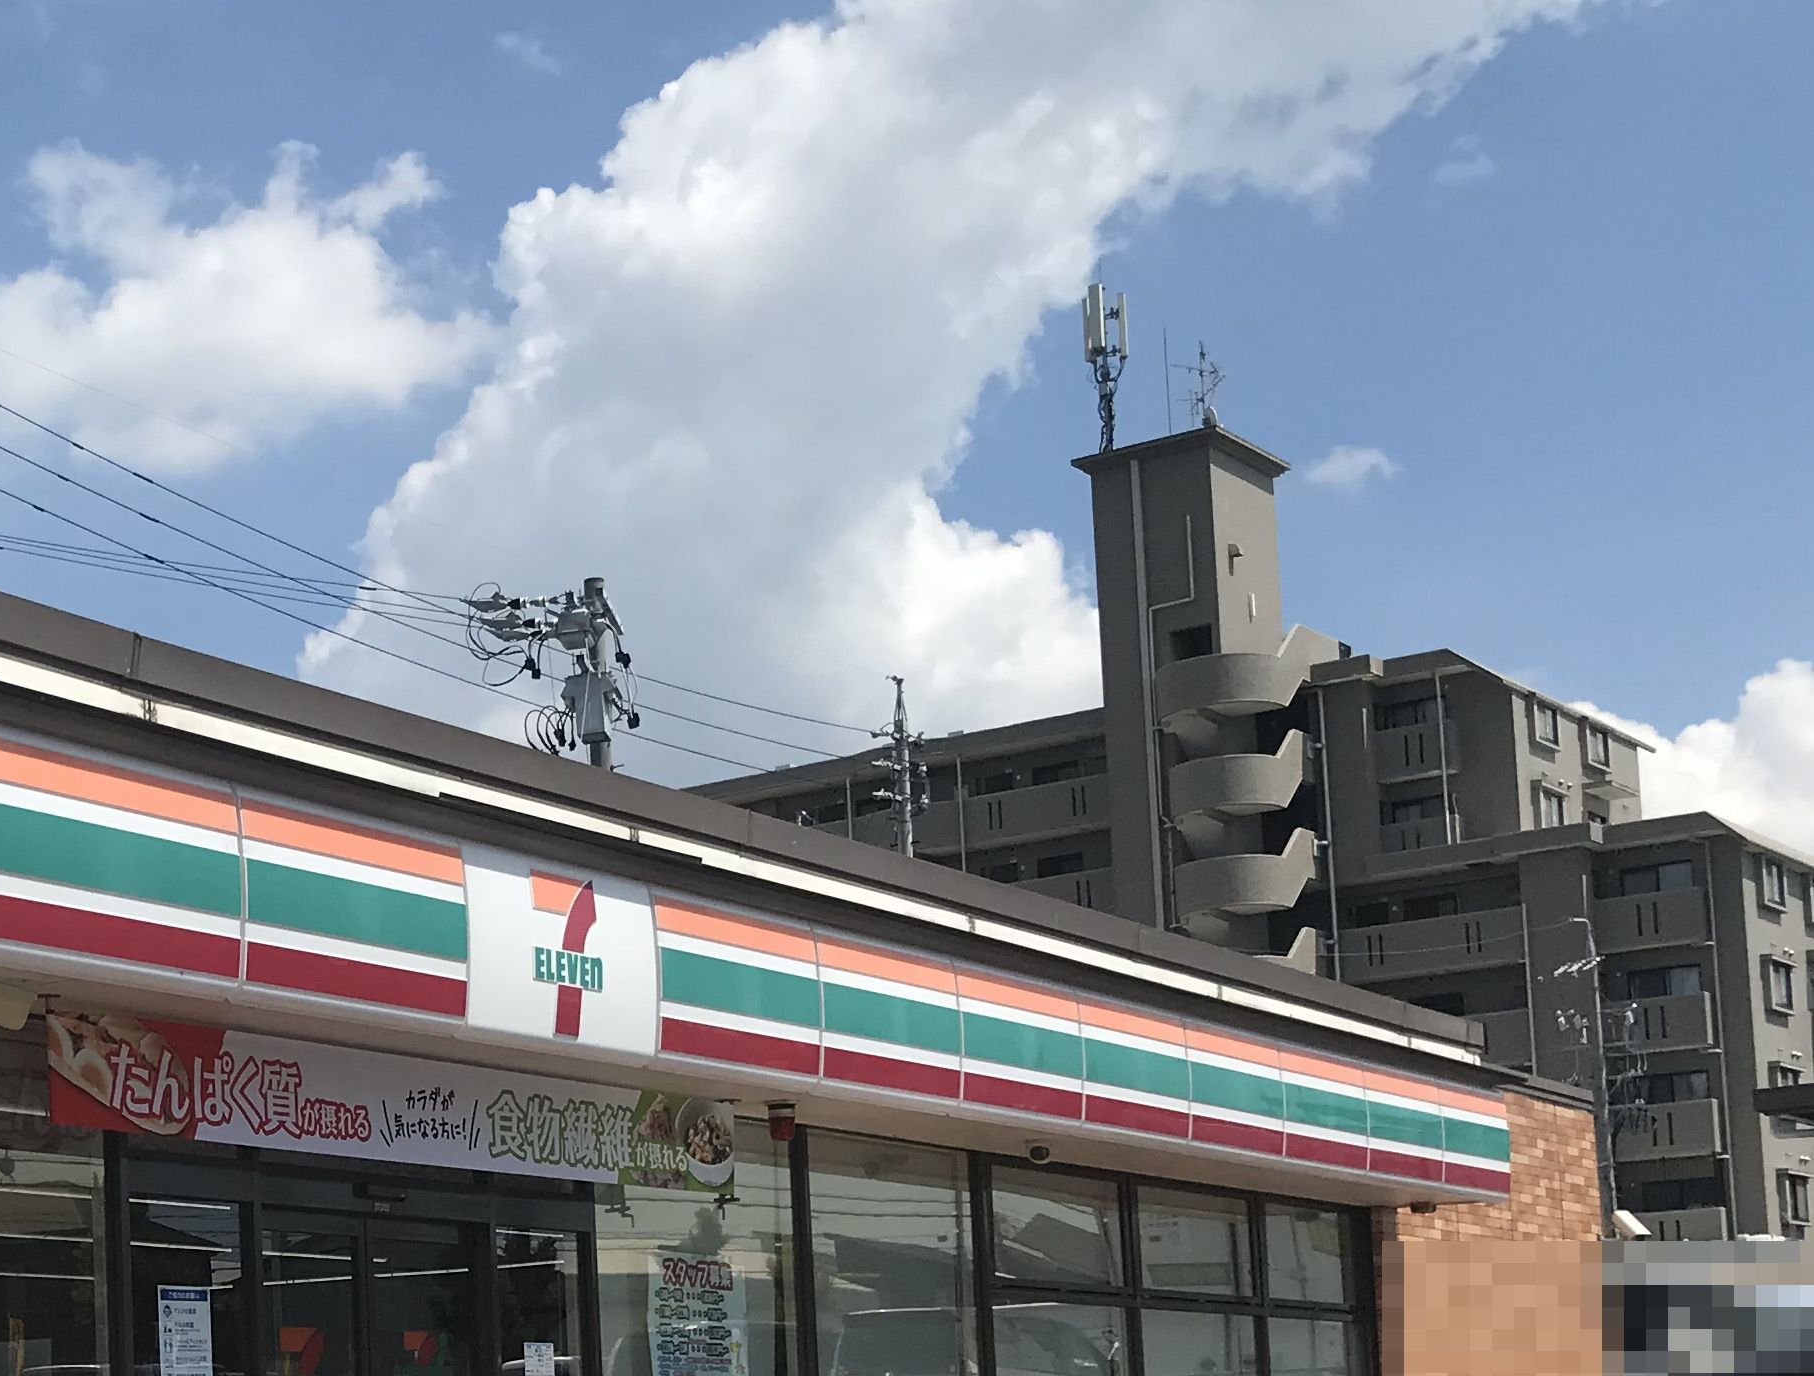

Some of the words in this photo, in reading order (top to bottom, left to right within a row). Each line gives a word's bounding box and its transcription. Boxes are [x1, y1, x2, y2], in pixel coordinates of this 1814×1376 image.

[108, 1040, 372, 1142] たんぱく質が摂れる
[405, 1085, 455, 1111] カラダが
[487, 1088, 690, 1172] 食物繊維が摂れる
